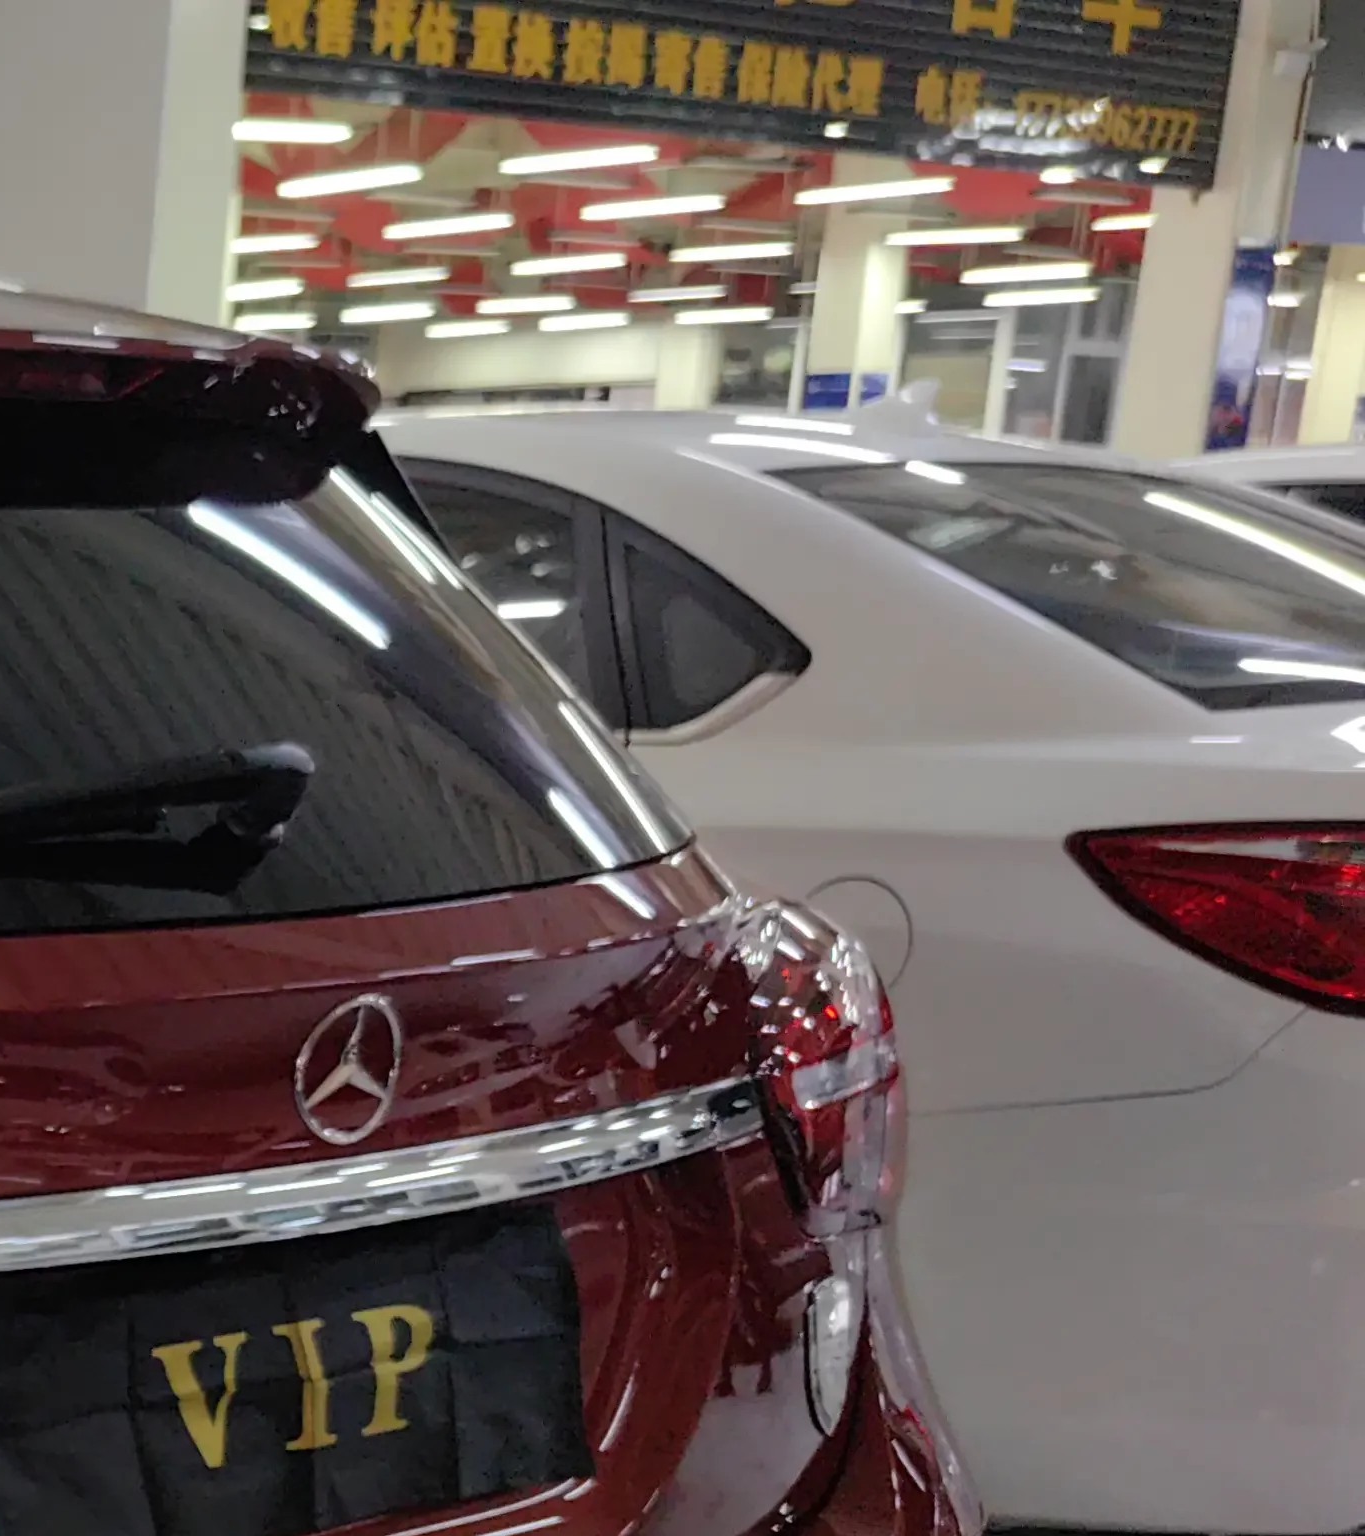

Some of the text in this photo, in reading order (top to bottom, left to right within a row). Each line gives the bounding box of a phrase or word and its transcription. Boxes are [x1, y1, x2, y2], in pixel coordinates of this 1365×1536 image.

[466, 5, 556, 79] 置换
[563, 18, 647, 89] 按揭
[654, 29, 727, 99] 寄售
[737, 40, 884, 117] 保险代理
[151, 1304, 435, 1468] VIP
